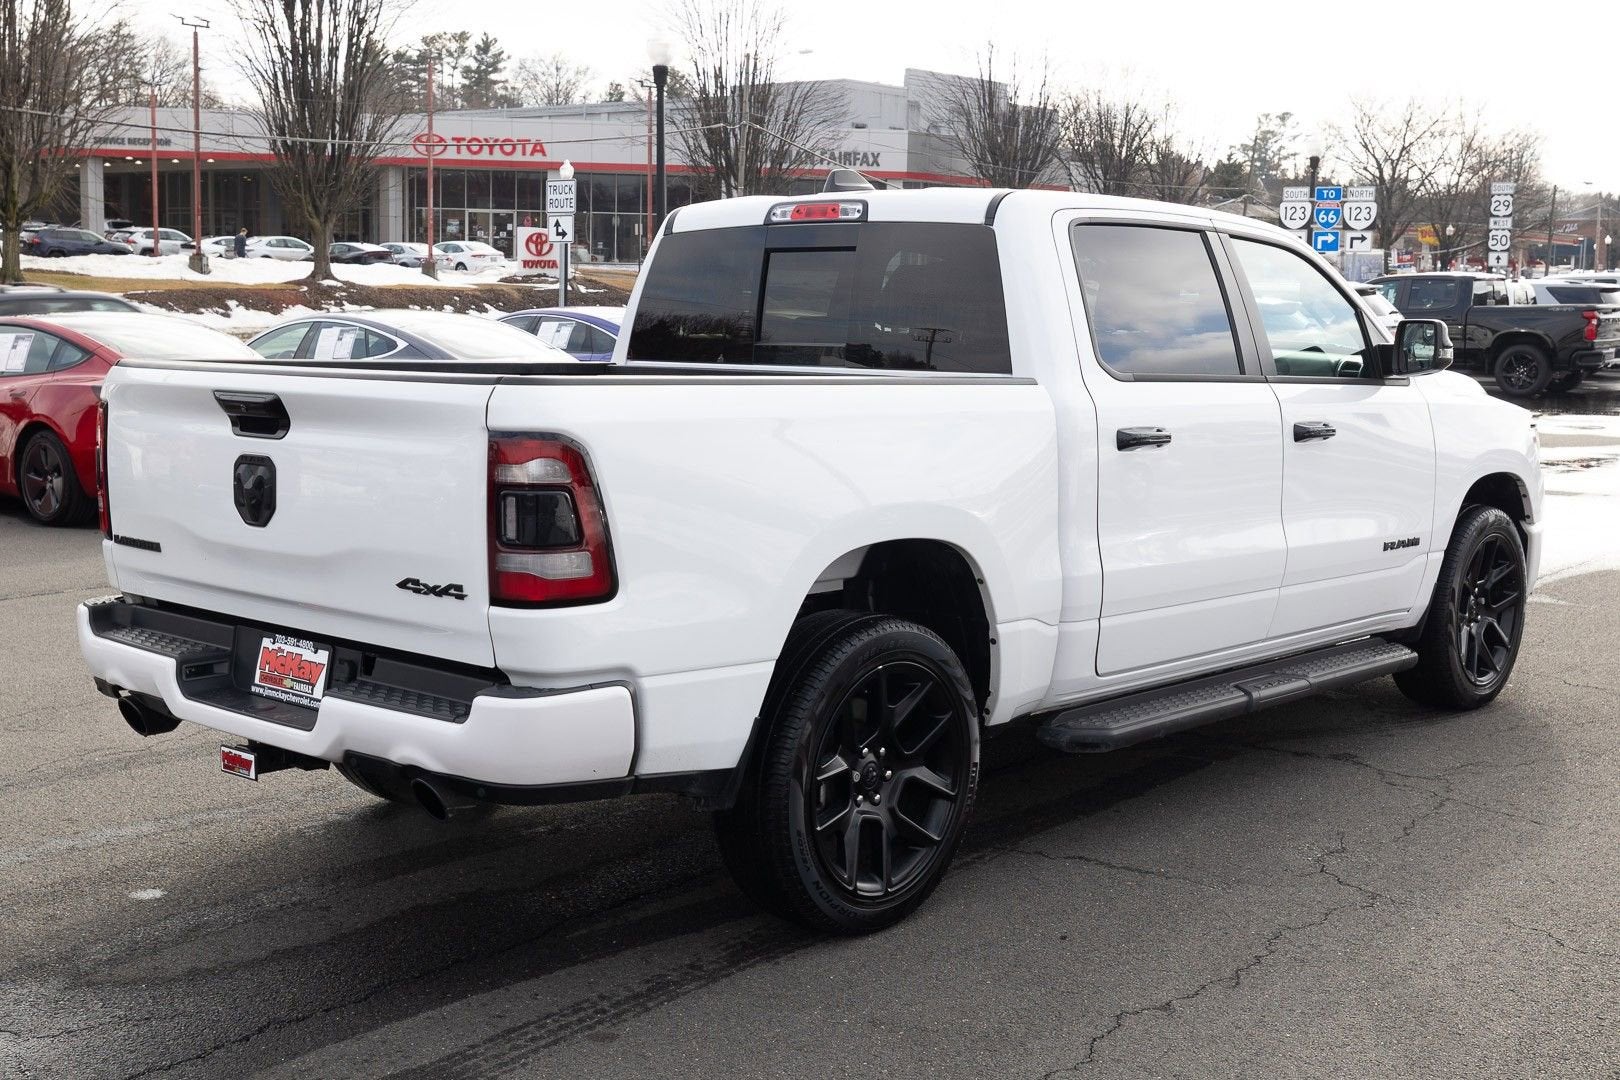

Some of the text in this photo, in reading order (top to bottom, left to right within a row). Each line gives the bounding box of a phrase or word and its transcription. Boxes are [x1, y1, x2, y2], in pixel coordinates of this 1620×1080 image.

[127, 137, 172, 147] RECEPION
[452, 136, 547, 157] TOYOTA
[819, 150, 880, 167] FAIRFAX
[549, 184, 573, 195] TRUCK
[1349, 189, 1374, 198] NORTH
[1492, 184, 1514, 192] SOUTH
[1285, 190, 1308, 199] SOUTH
[1322, 190, 1335, 199] TO
[549, 198, 574, 209] ROUTE
[1493, 200, 1511, 211] 29
[1284, 206, 1307, 221] 123
[1318, 210, 1337, 223] 66
[1349, 206, 1372, 221] 123
[1492, 219, 1509, 227] WEST
[1491, 235, 1508, 246] 50
[521, 259, 558, 269] TOYOTA
[259, 646, 326, 686] McKay
[293, 681, 313, 694] FAIRFAX
